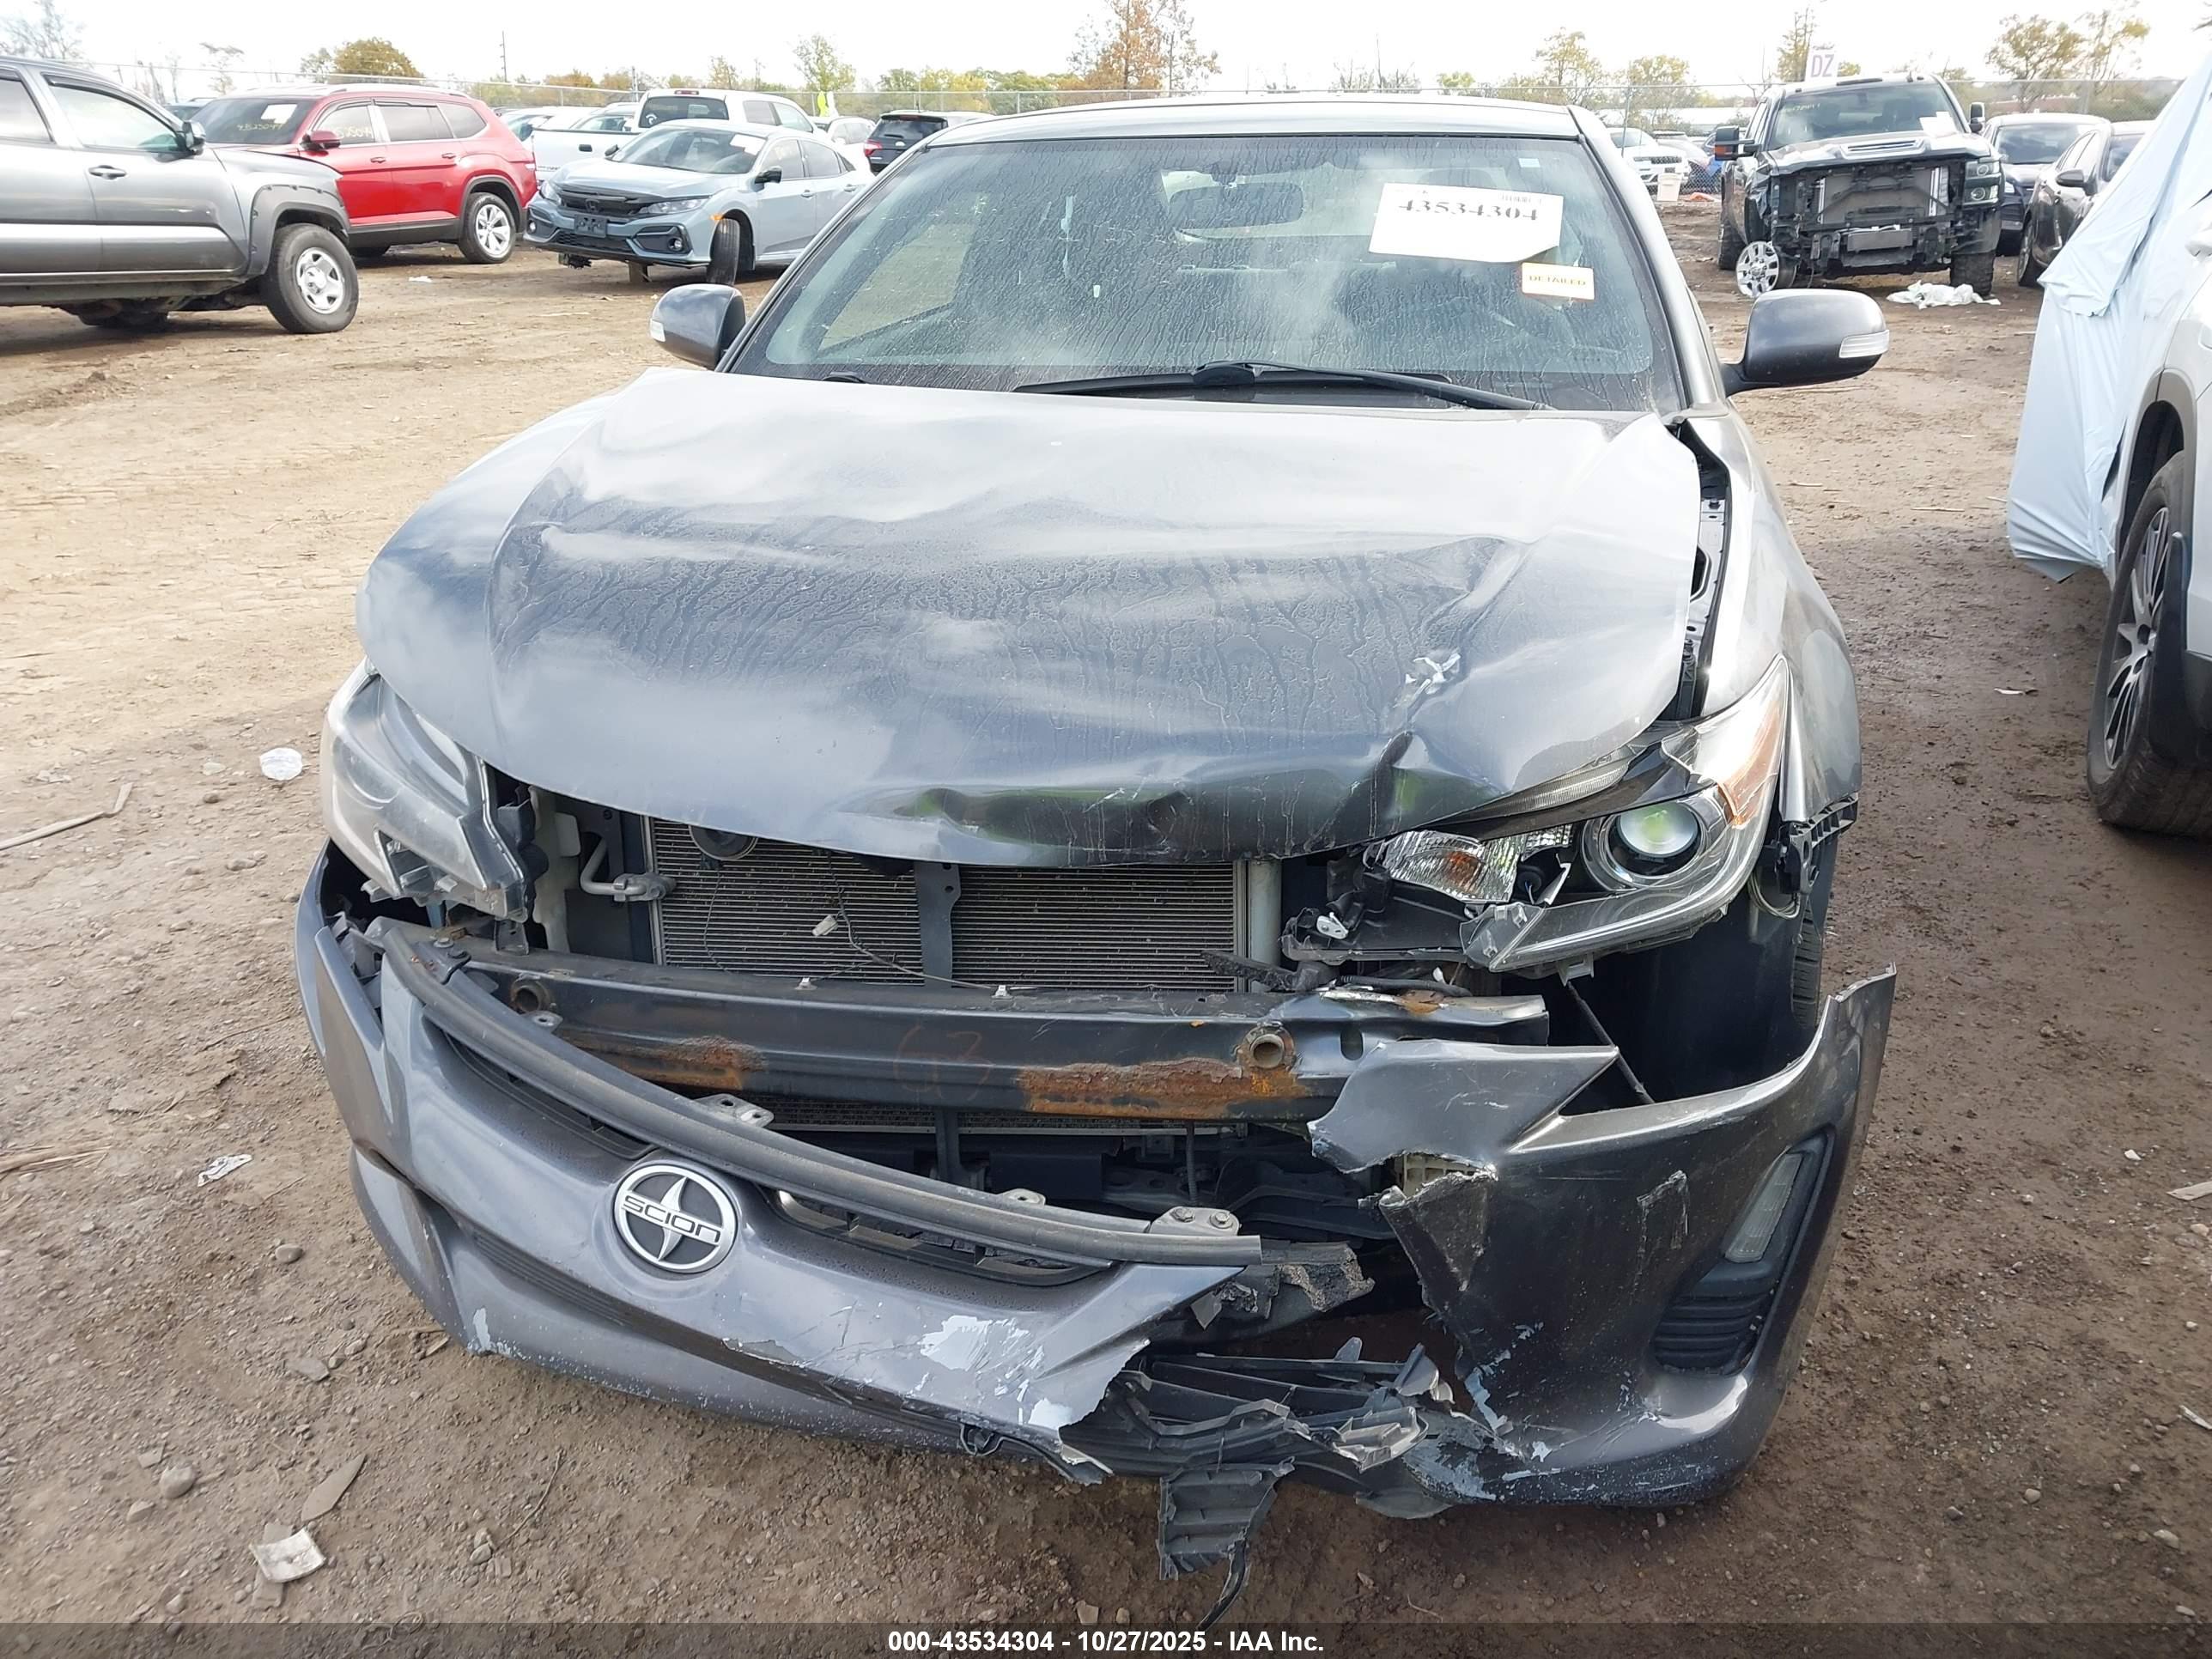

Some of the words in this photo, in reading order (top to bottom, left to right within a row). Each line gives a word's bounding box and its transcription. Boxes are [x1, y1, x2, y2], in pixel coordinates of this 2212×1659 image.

[1810, 53, 1835, 78] DZ
[1398, 198, 1539, 221] 43534304
[1528, 274, 1587, 287] DETAILED
[623, 1194, 722, 1243] SCION
